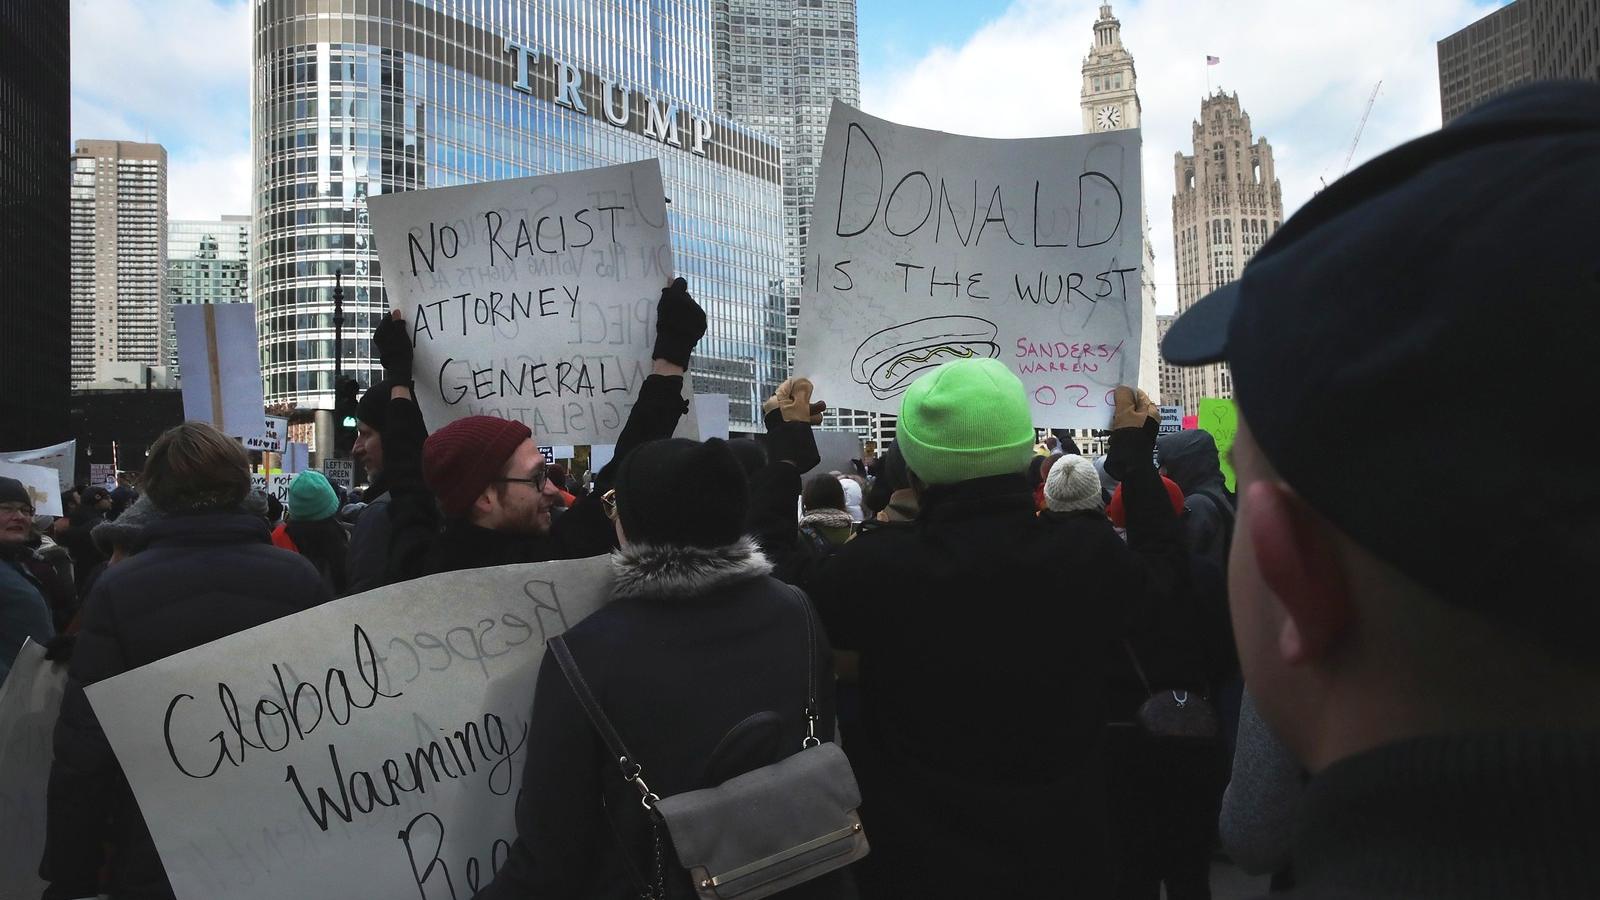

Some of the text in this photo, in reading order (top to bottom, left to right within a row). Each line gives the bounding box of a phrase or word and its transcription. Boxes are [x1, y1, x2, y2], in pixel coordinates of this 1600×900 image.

[504, 37, 712, 157] TRUMP
[836, 122, 1123, 248] DONALD
[408, 207, 625, 276] NO RACIST
[816, 254, 853, 292] IS
[895, 262, 989, 299] THE
[1015, 267, 1137, 304] WURST
[413, 286, 579, 348] ATTORNEY
[1016, 337, 1124, 361] SANDERS/
[1019, 362, 1098, 375] WARREN
[439, 358, 627, 405] GENERAL
[1030, 385, 1115, 408] 02
[274, 474, 292, 485] not
[326, 461, 352, 469] LEFT ON
[328, 470, 350, 478] GREEN
[163, 624, 402, 778] Global
[284, 712, 528, 832] Warming
